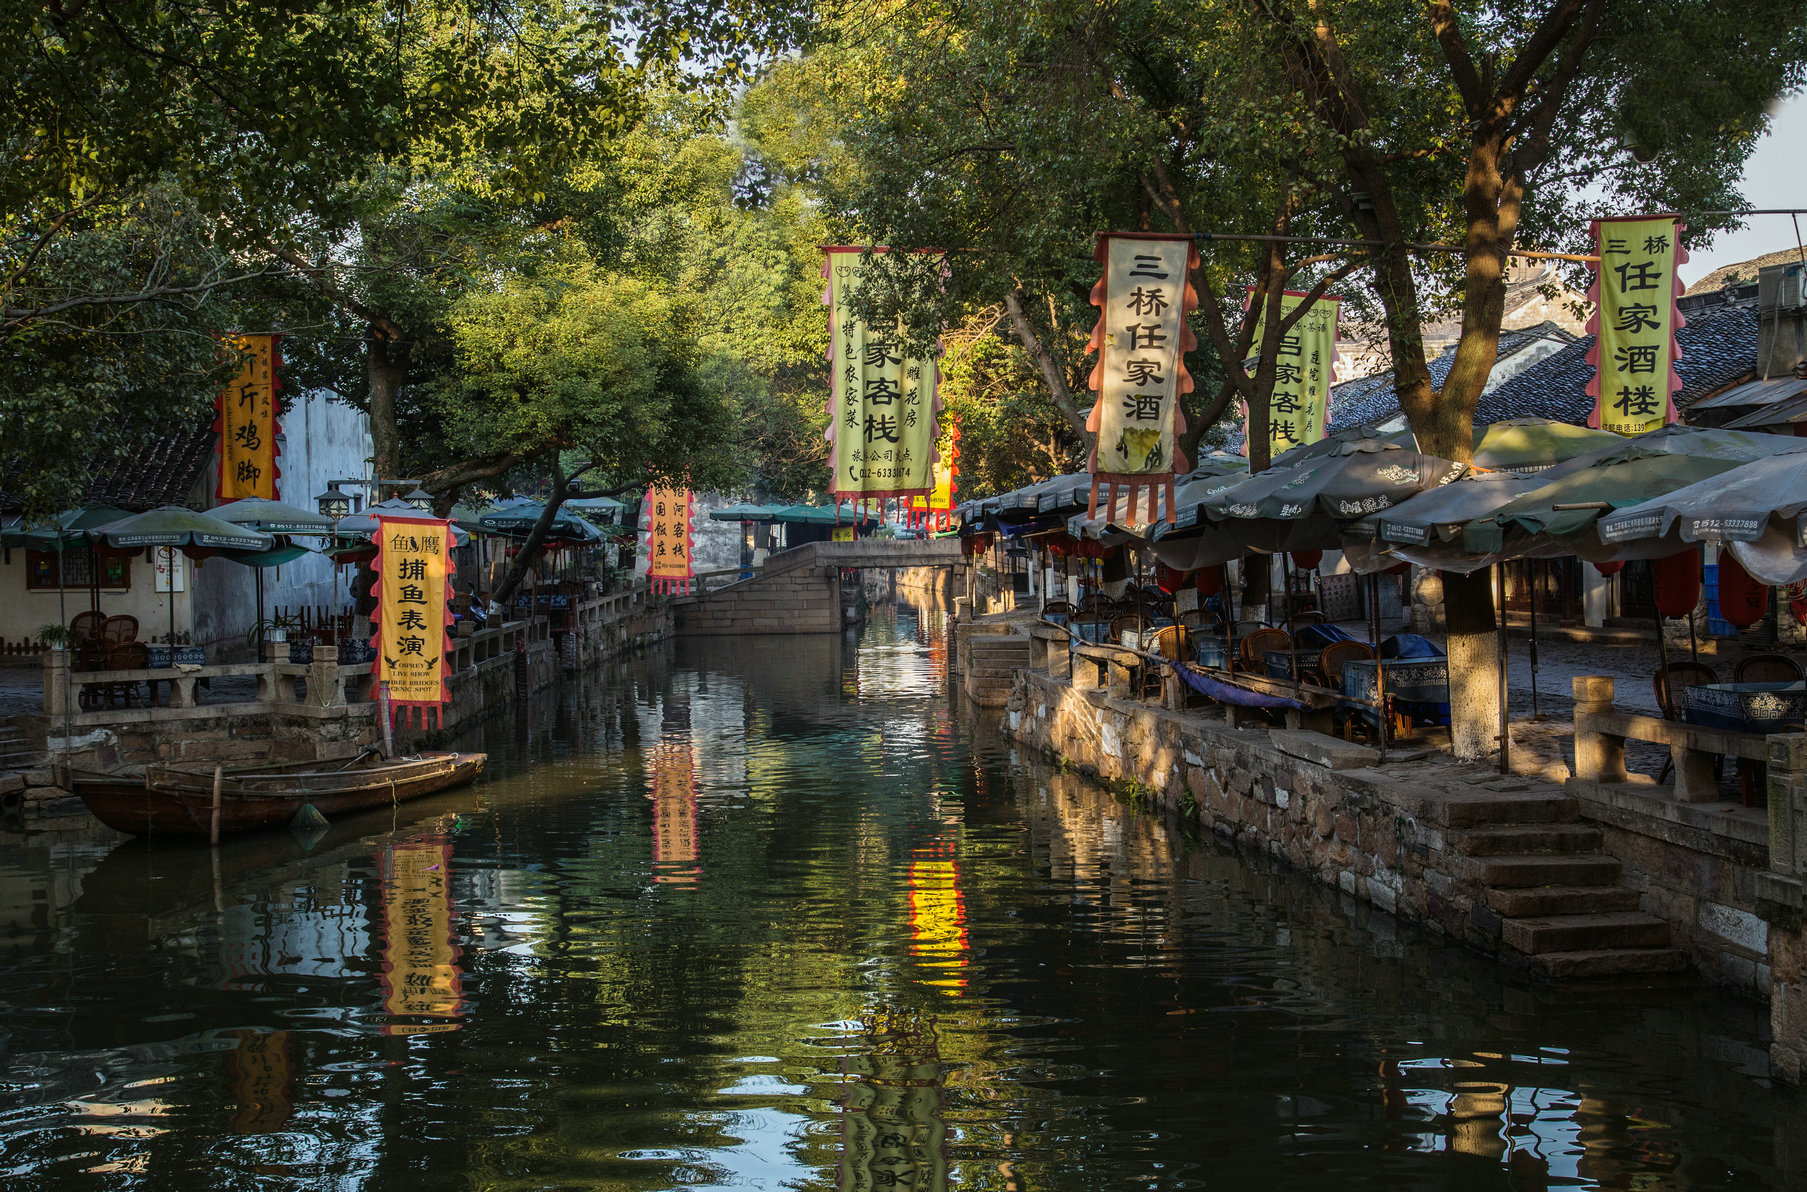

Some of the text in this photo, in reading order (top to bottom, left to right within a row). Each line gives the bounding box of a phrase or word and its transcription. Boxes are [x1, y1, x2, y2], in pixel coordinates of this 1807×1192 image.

[1605, 235, 1670, 255] 三桥
[841, 321, 859, 429] 特色农家菜
[1116, 254, 1169, 470] 三桥任家酒
[1613, 261, 1662, 417] 任家酒楼
[390, 533, 440, 555] 鱼鹰
[397, 558, 428, 657] 捕鱼表演
